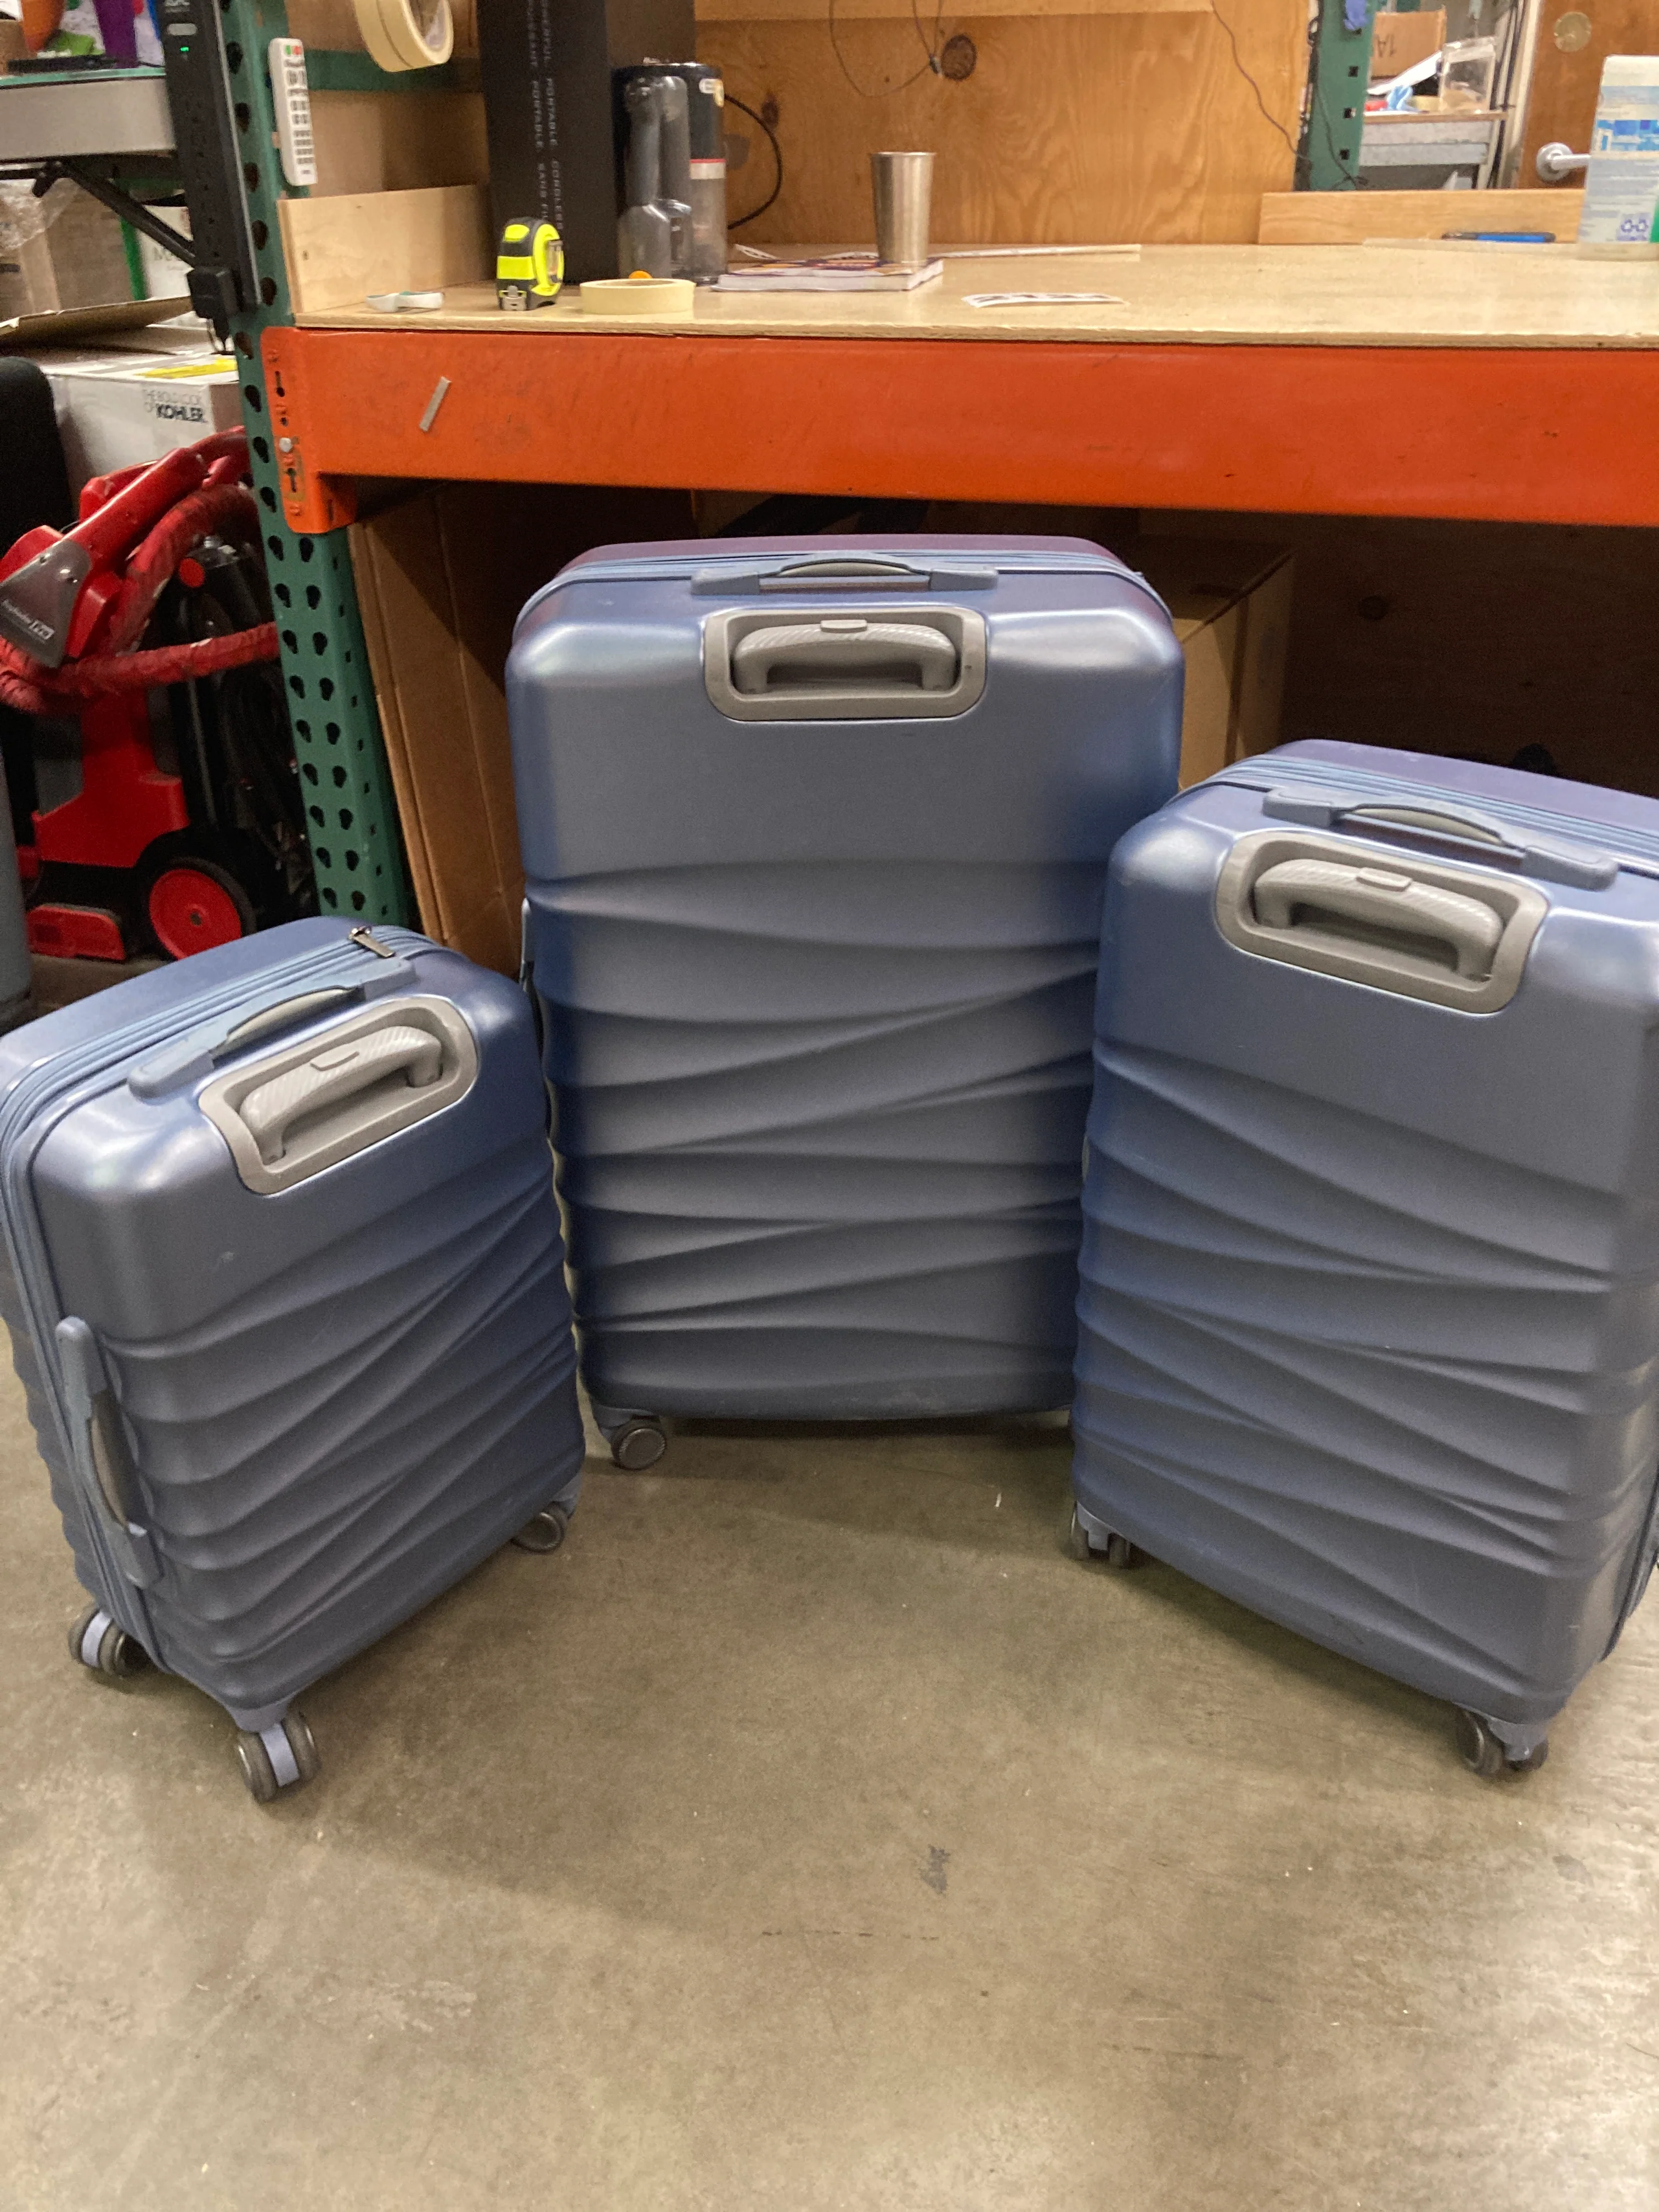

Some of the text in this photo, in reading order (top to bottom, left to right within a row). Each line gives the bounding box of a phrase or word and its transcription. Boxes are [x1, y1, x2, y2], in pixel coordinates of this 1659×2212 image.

[531, 81, 544, 148] PORTABLE
[546, 78, 558, 146] PORTABLE
[551, 159, 564, 230] CORDLESS
[156, 403, 206, 424] KOHLER
